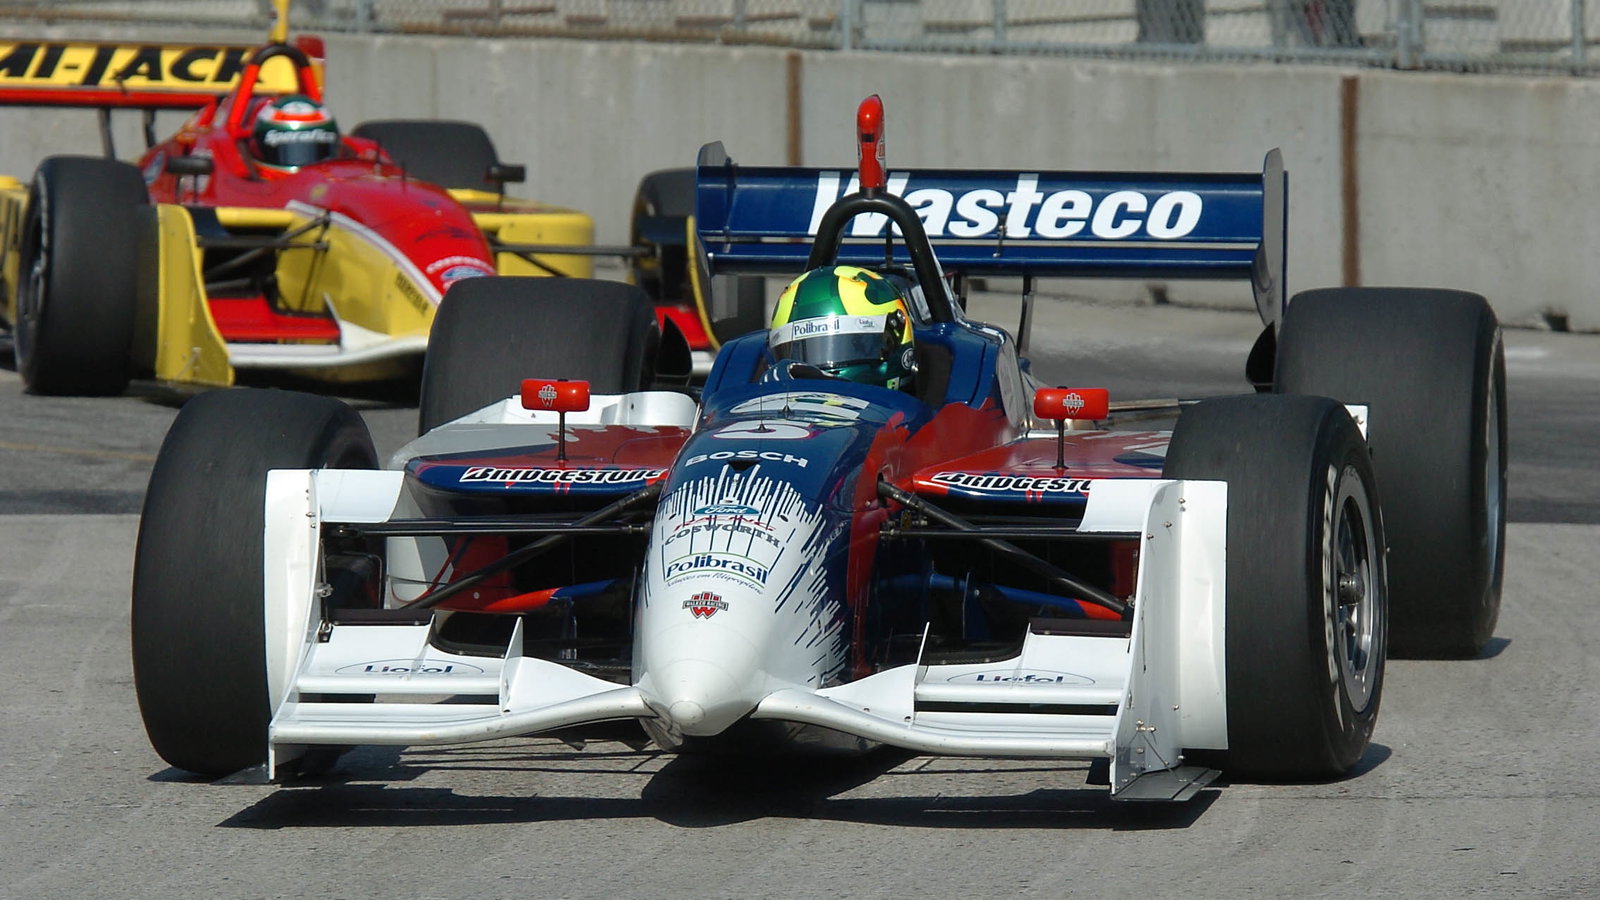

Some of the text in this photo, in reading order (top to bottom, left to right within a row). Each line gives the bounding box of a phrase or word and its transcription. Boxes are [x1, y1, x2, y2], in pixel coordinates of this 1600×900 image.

[807, 171, 1203, 240] Wasteco
[794, 319, 840, 336] Polibrail
[685, 450, 808, 468] BOSCH
[931, 471, 1092, 493] BRIDGEST
[704, 505, 748, 514] Ford
[665, 523, 780, 548] COSWORTH
[666, 555, 768, 584] Polibrasil
